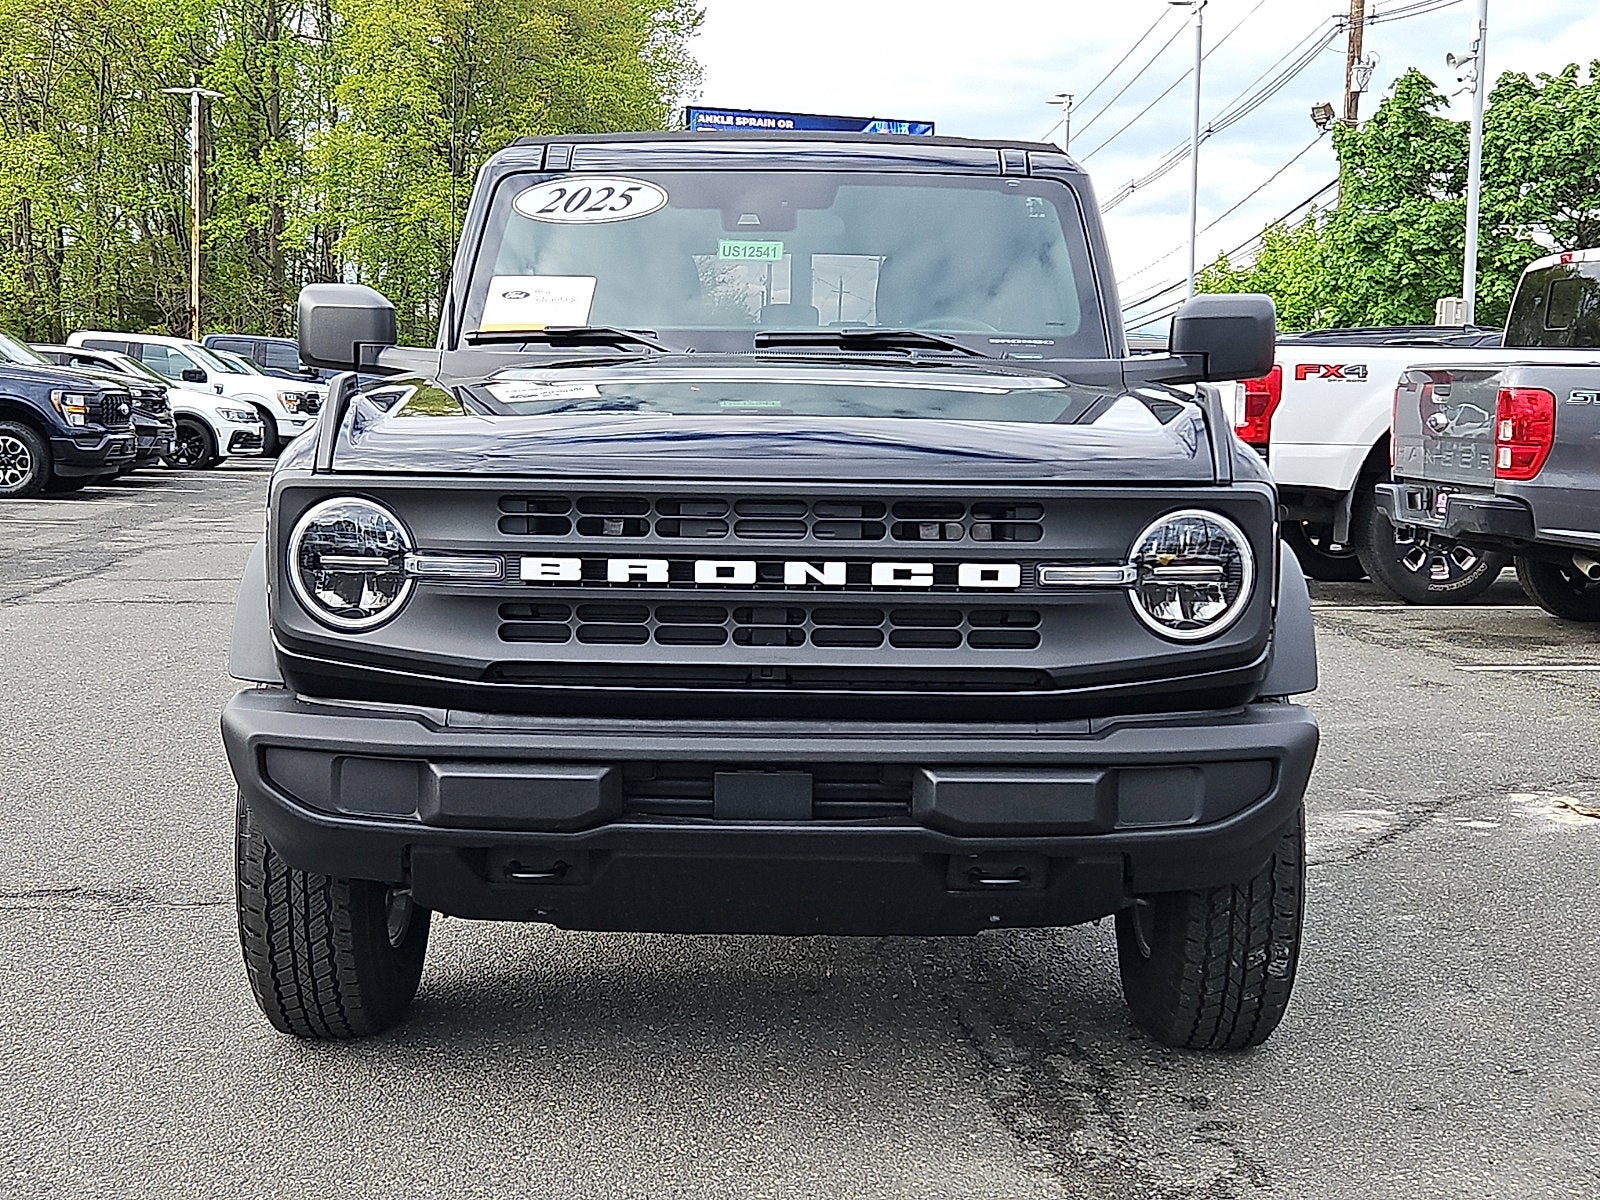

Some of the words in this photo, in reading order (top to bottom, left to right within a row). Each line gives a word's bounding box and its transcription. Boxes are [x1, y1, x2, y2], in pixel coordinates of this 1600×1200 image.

[698, 114, 733, 126] ANKLE
[735, 116, 775, 129] SPRAIN
[777, 119, 794, 129] OR
[536, 187, 643, 213] 2025
[722, 245, 777, 258] US12541
[1295, 364, 1368, 380] FX4
[520, 557, 1021, 588] BRONCO
[1427, 562, 1488, 592] MICHELIN
